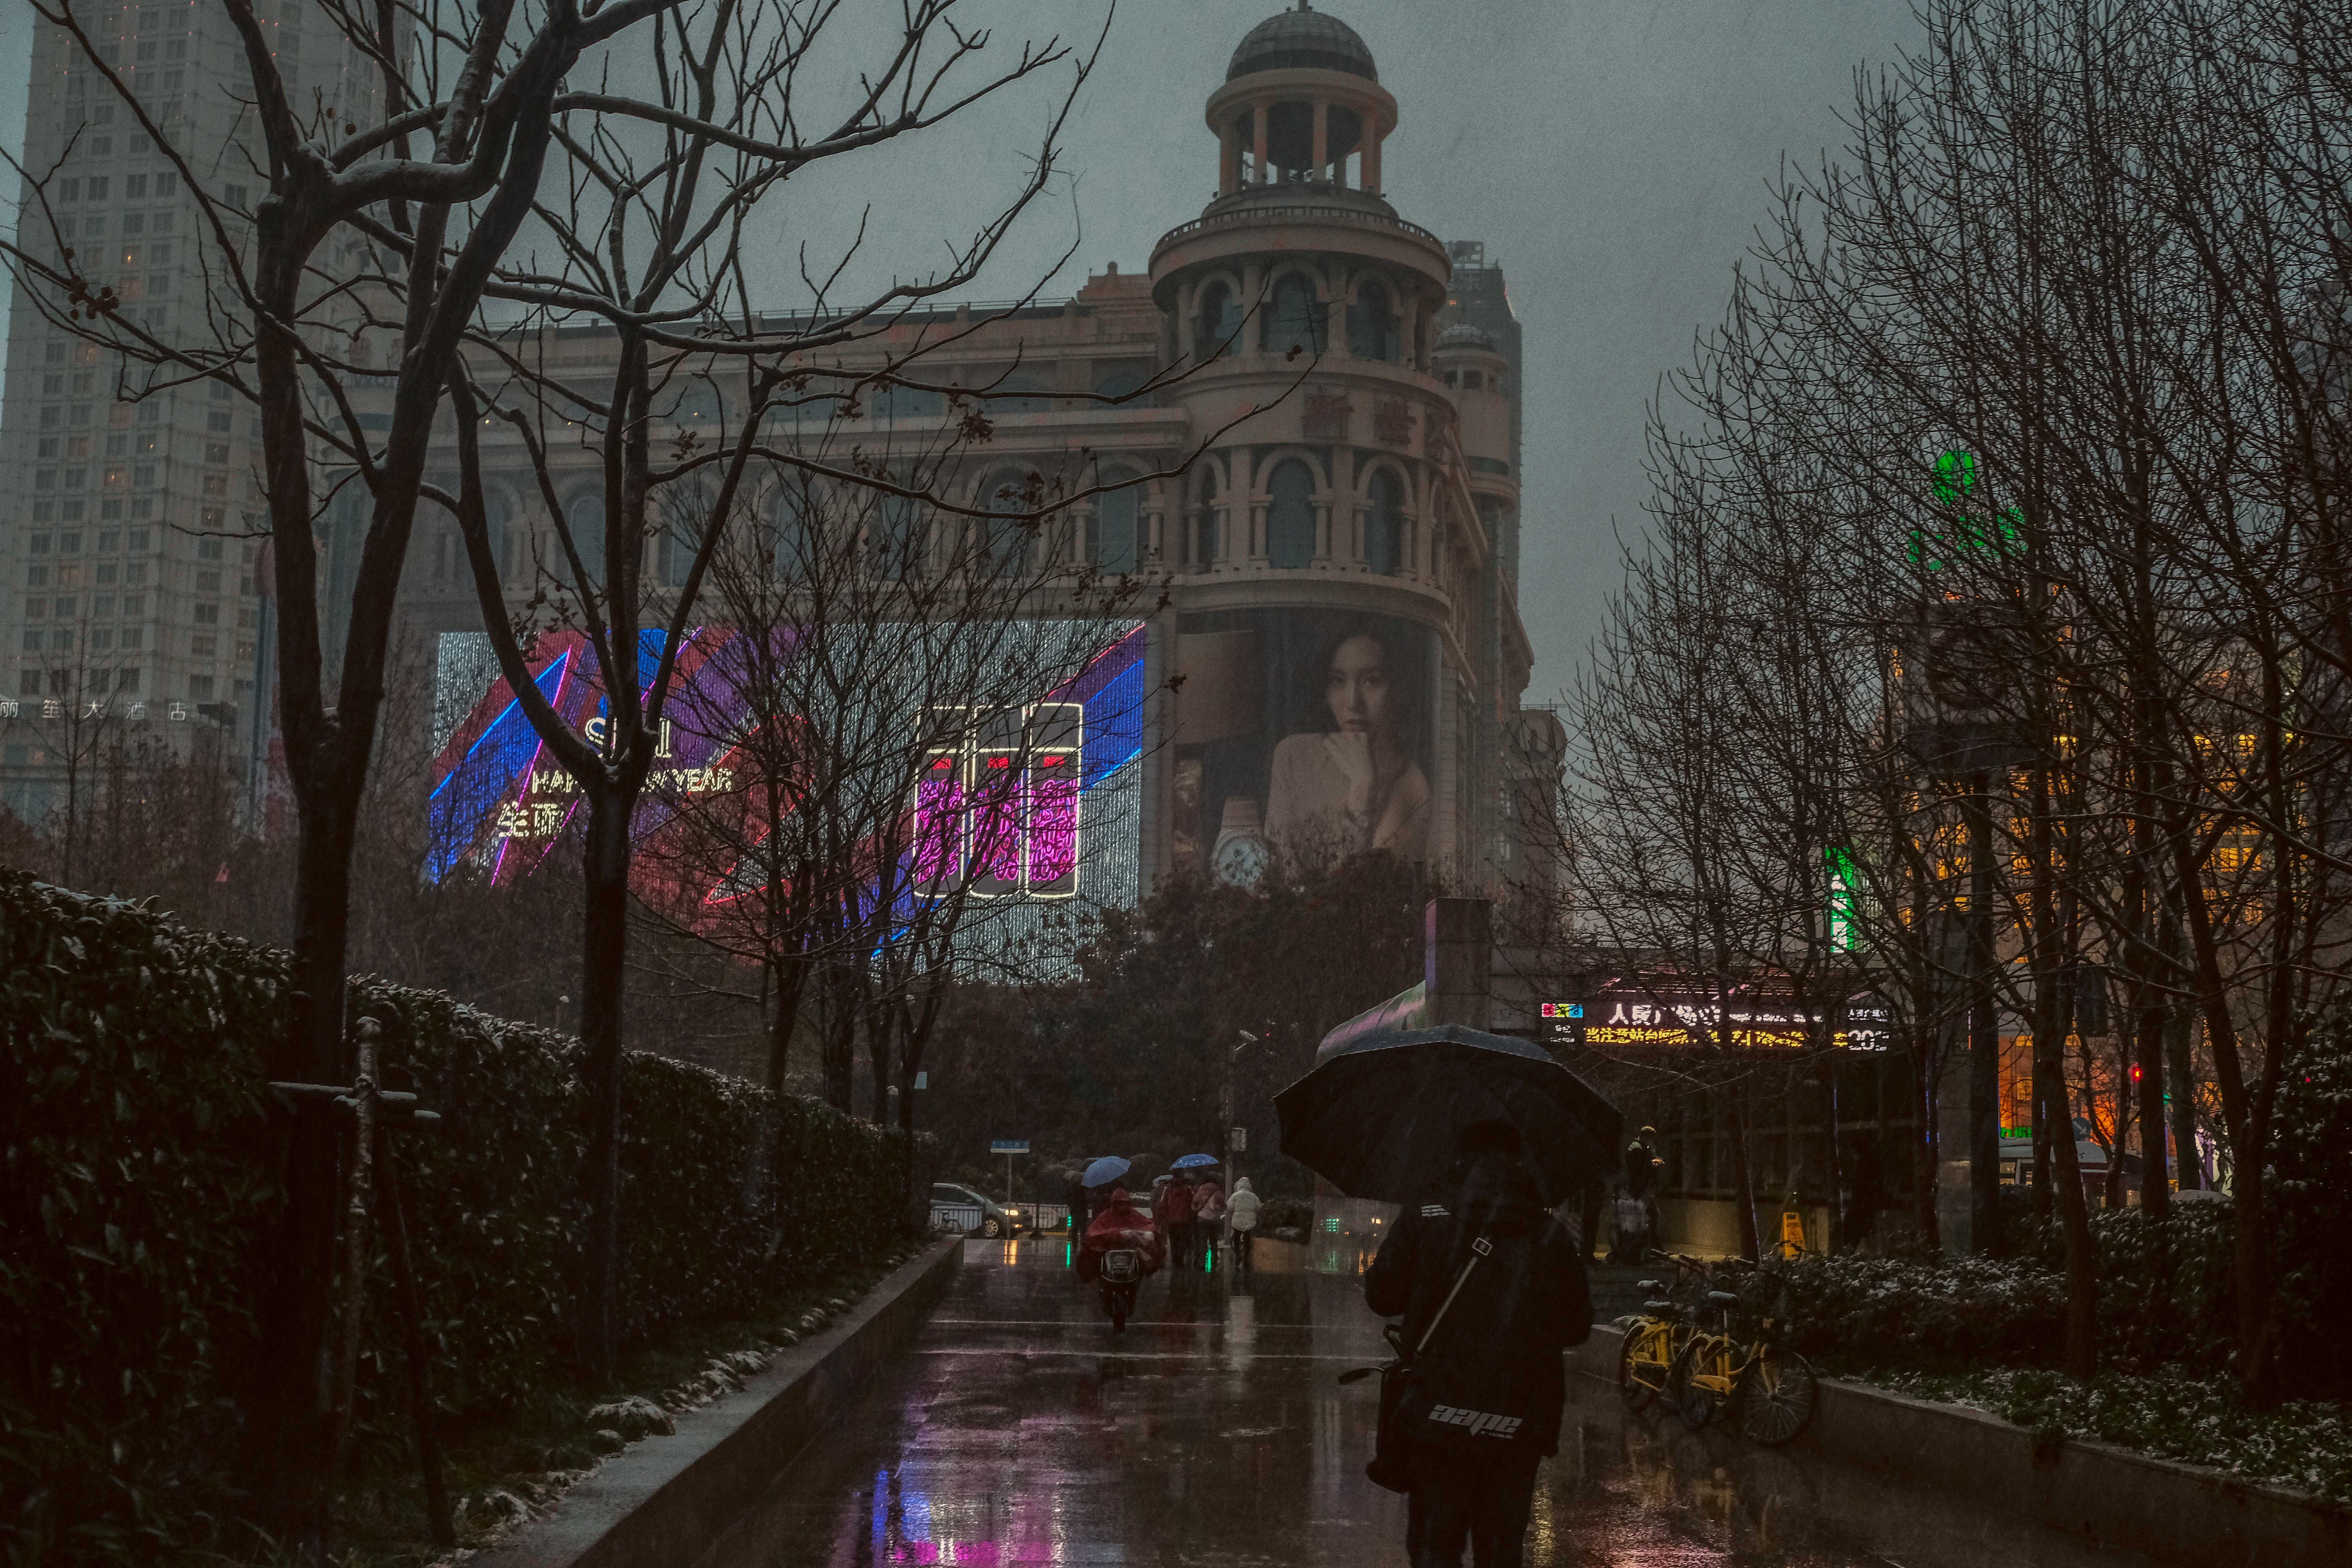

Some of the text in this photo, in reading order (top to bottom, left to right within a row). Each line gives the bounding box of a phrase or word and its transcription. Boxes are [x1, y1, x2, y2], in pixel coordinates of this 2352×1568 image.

[0, 699, 186, 720] 丽笙大酒店
[672, 768, 732, 792] YEAR
[1428, 1404, 1523, 1436] aape
